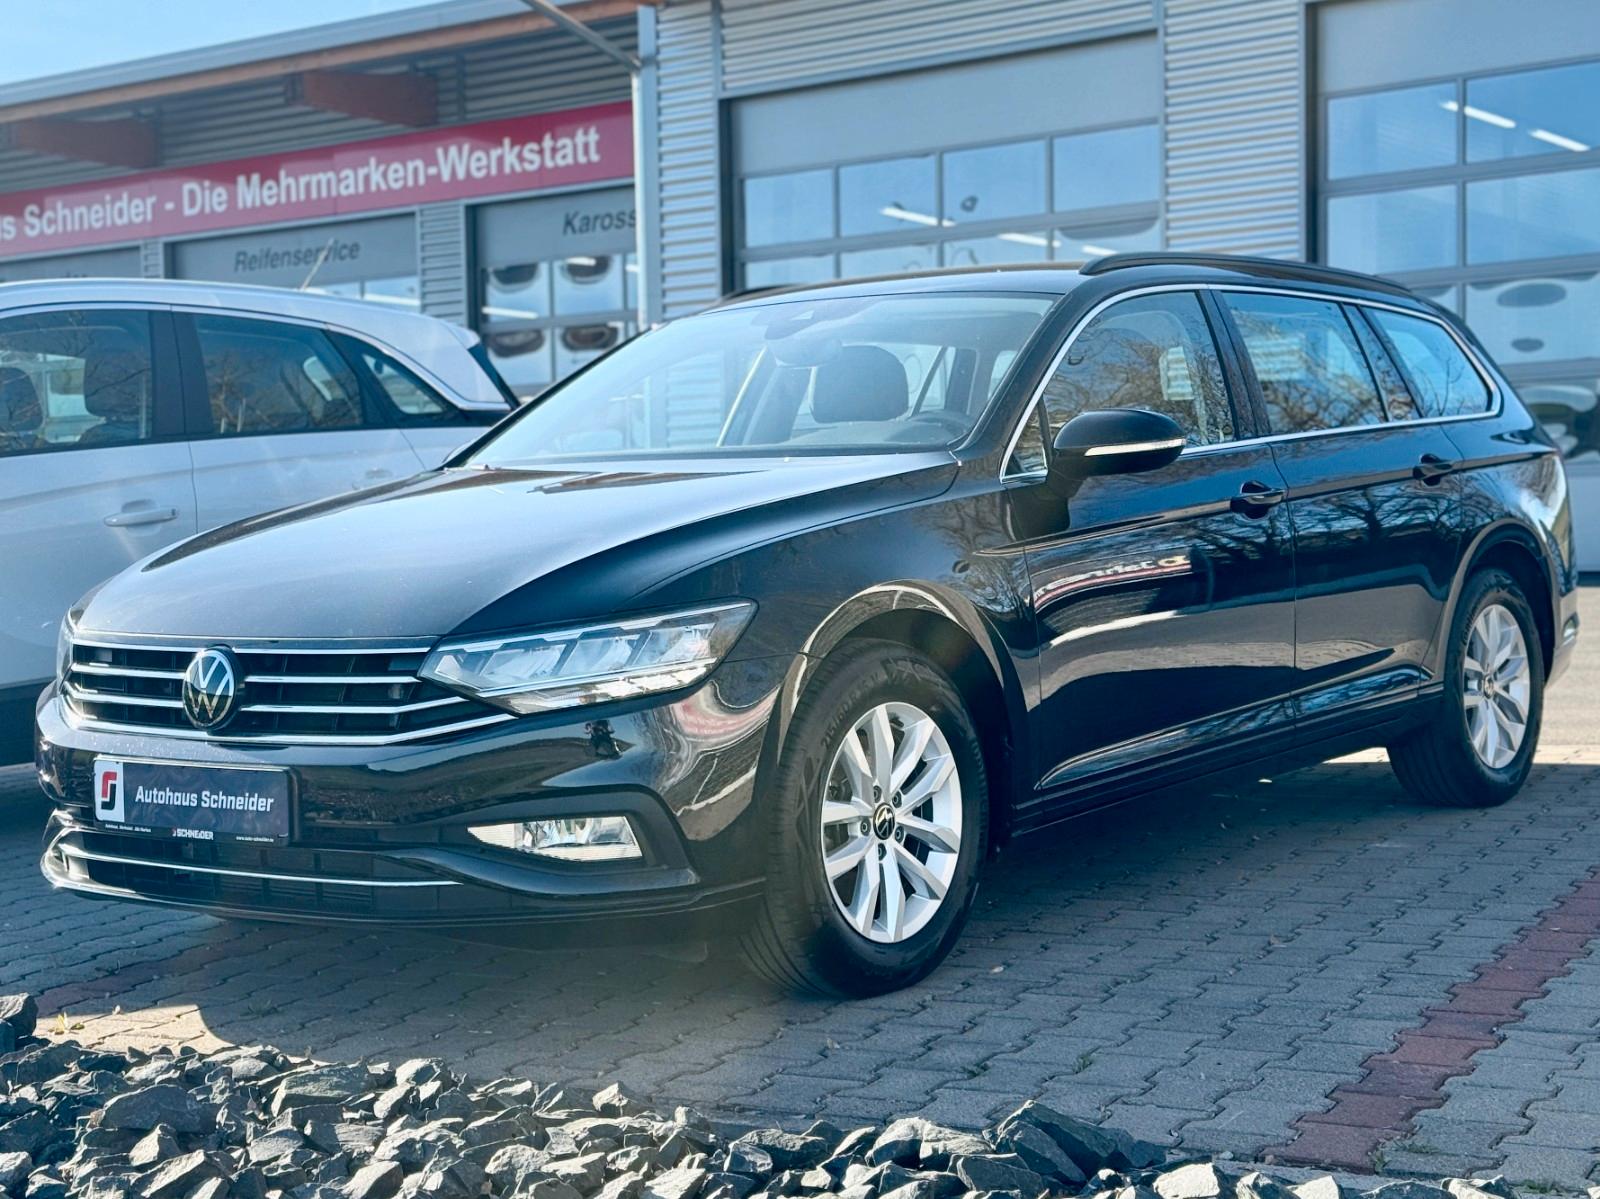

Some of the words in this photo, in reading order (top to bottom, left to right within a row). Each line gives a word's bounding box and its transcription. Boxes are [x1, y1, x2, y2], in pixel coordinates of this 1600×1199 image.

[24, 191, 157, 238] Schneider
[182, 180, 228, 217] Die
[237, 125, 600, 210] Mehrmarken-Werkstatt
[234, 239, 360, 272] Reifenservice
[135, 786, 198, 807] Autohaus
[201, 790, 274, 812] Schneider
